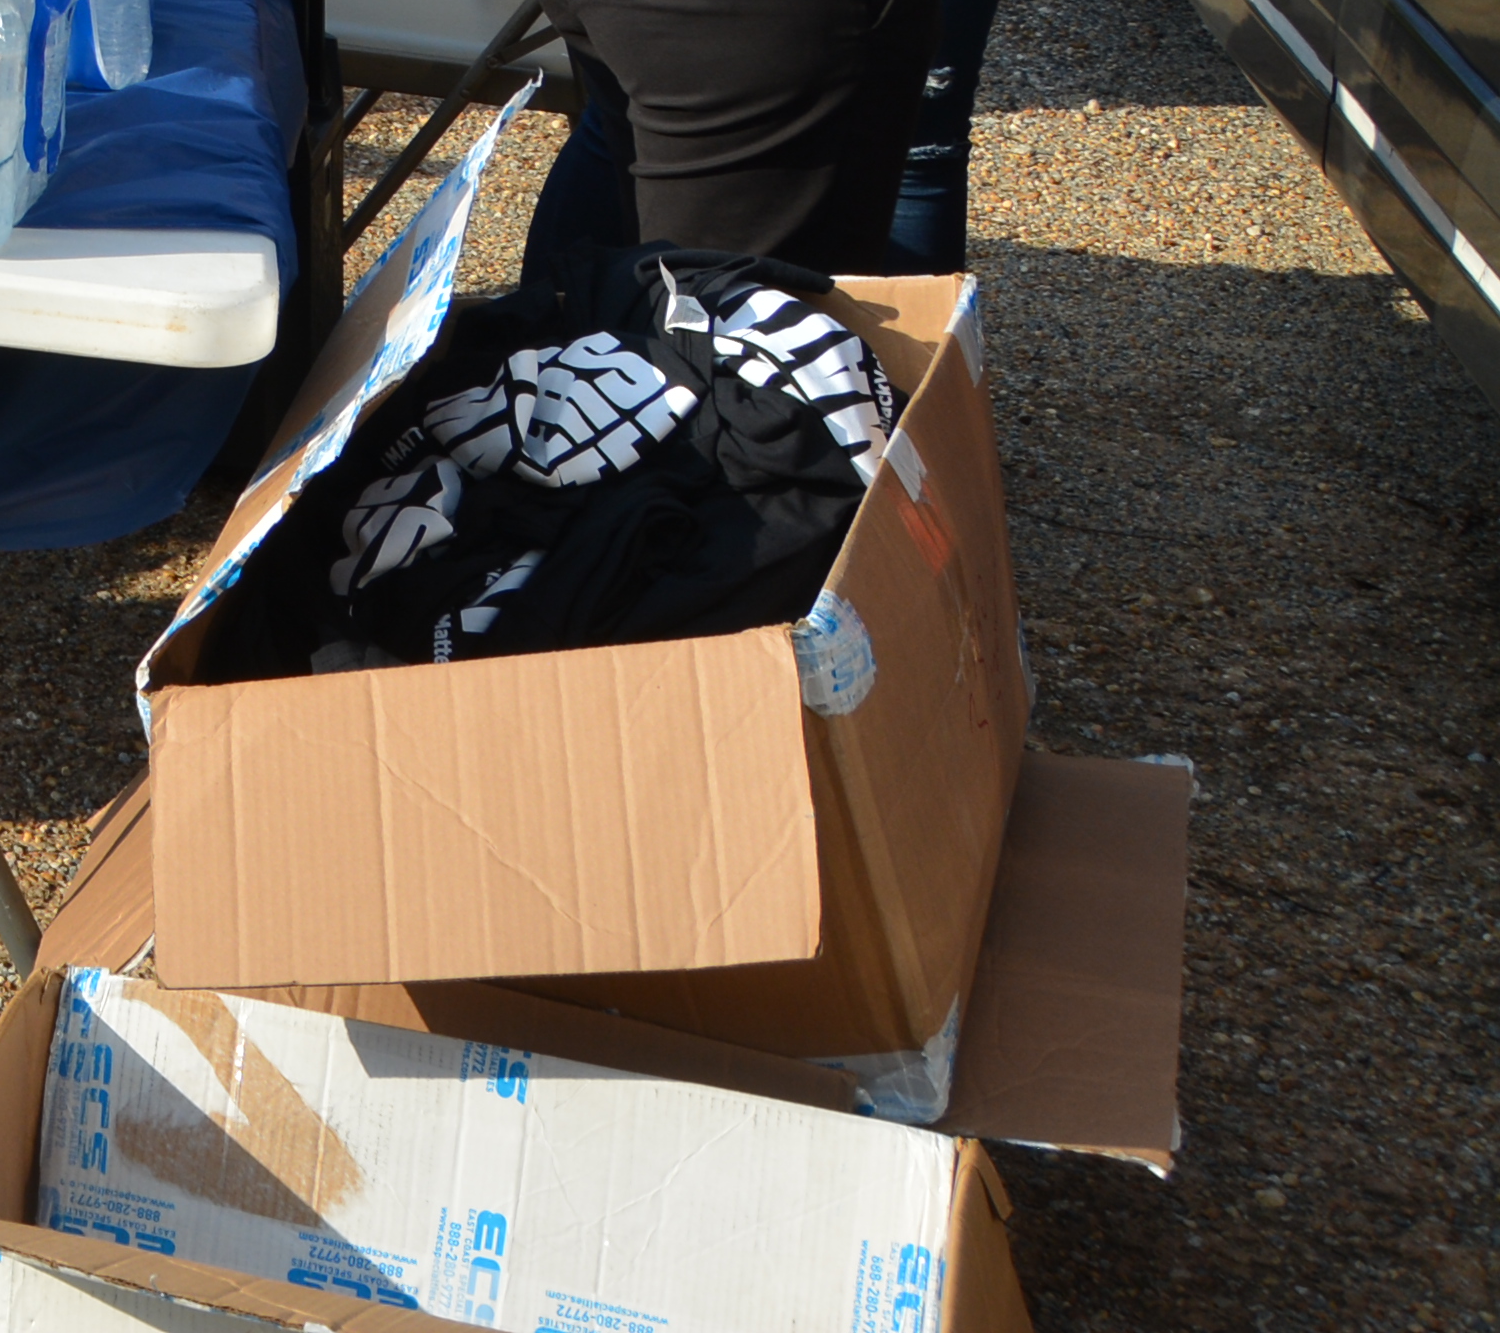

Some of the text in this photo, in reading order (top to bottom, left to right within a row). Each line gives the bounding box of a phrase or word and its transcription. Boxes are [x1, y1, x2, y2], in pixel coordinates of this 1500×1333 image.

[386, 428, 425, 468] MATT
[434, 612, 453, 664] Matte
[80, 1043, 113, 1175] ECS
[116, 1218, 147, 1234] COAST
[149, 1228, 176, 1239] EAST
[467, 1208, 477, 1234] EAST
[298, 1229, 419, 1267] www.ecspecialties.com
[308, 1245, 404, 1279] 888-280-9772
[461, 1237, 474, 1271] COAST
[291, 1257, 419, 1296] EAST COAST SPECIALTIES
